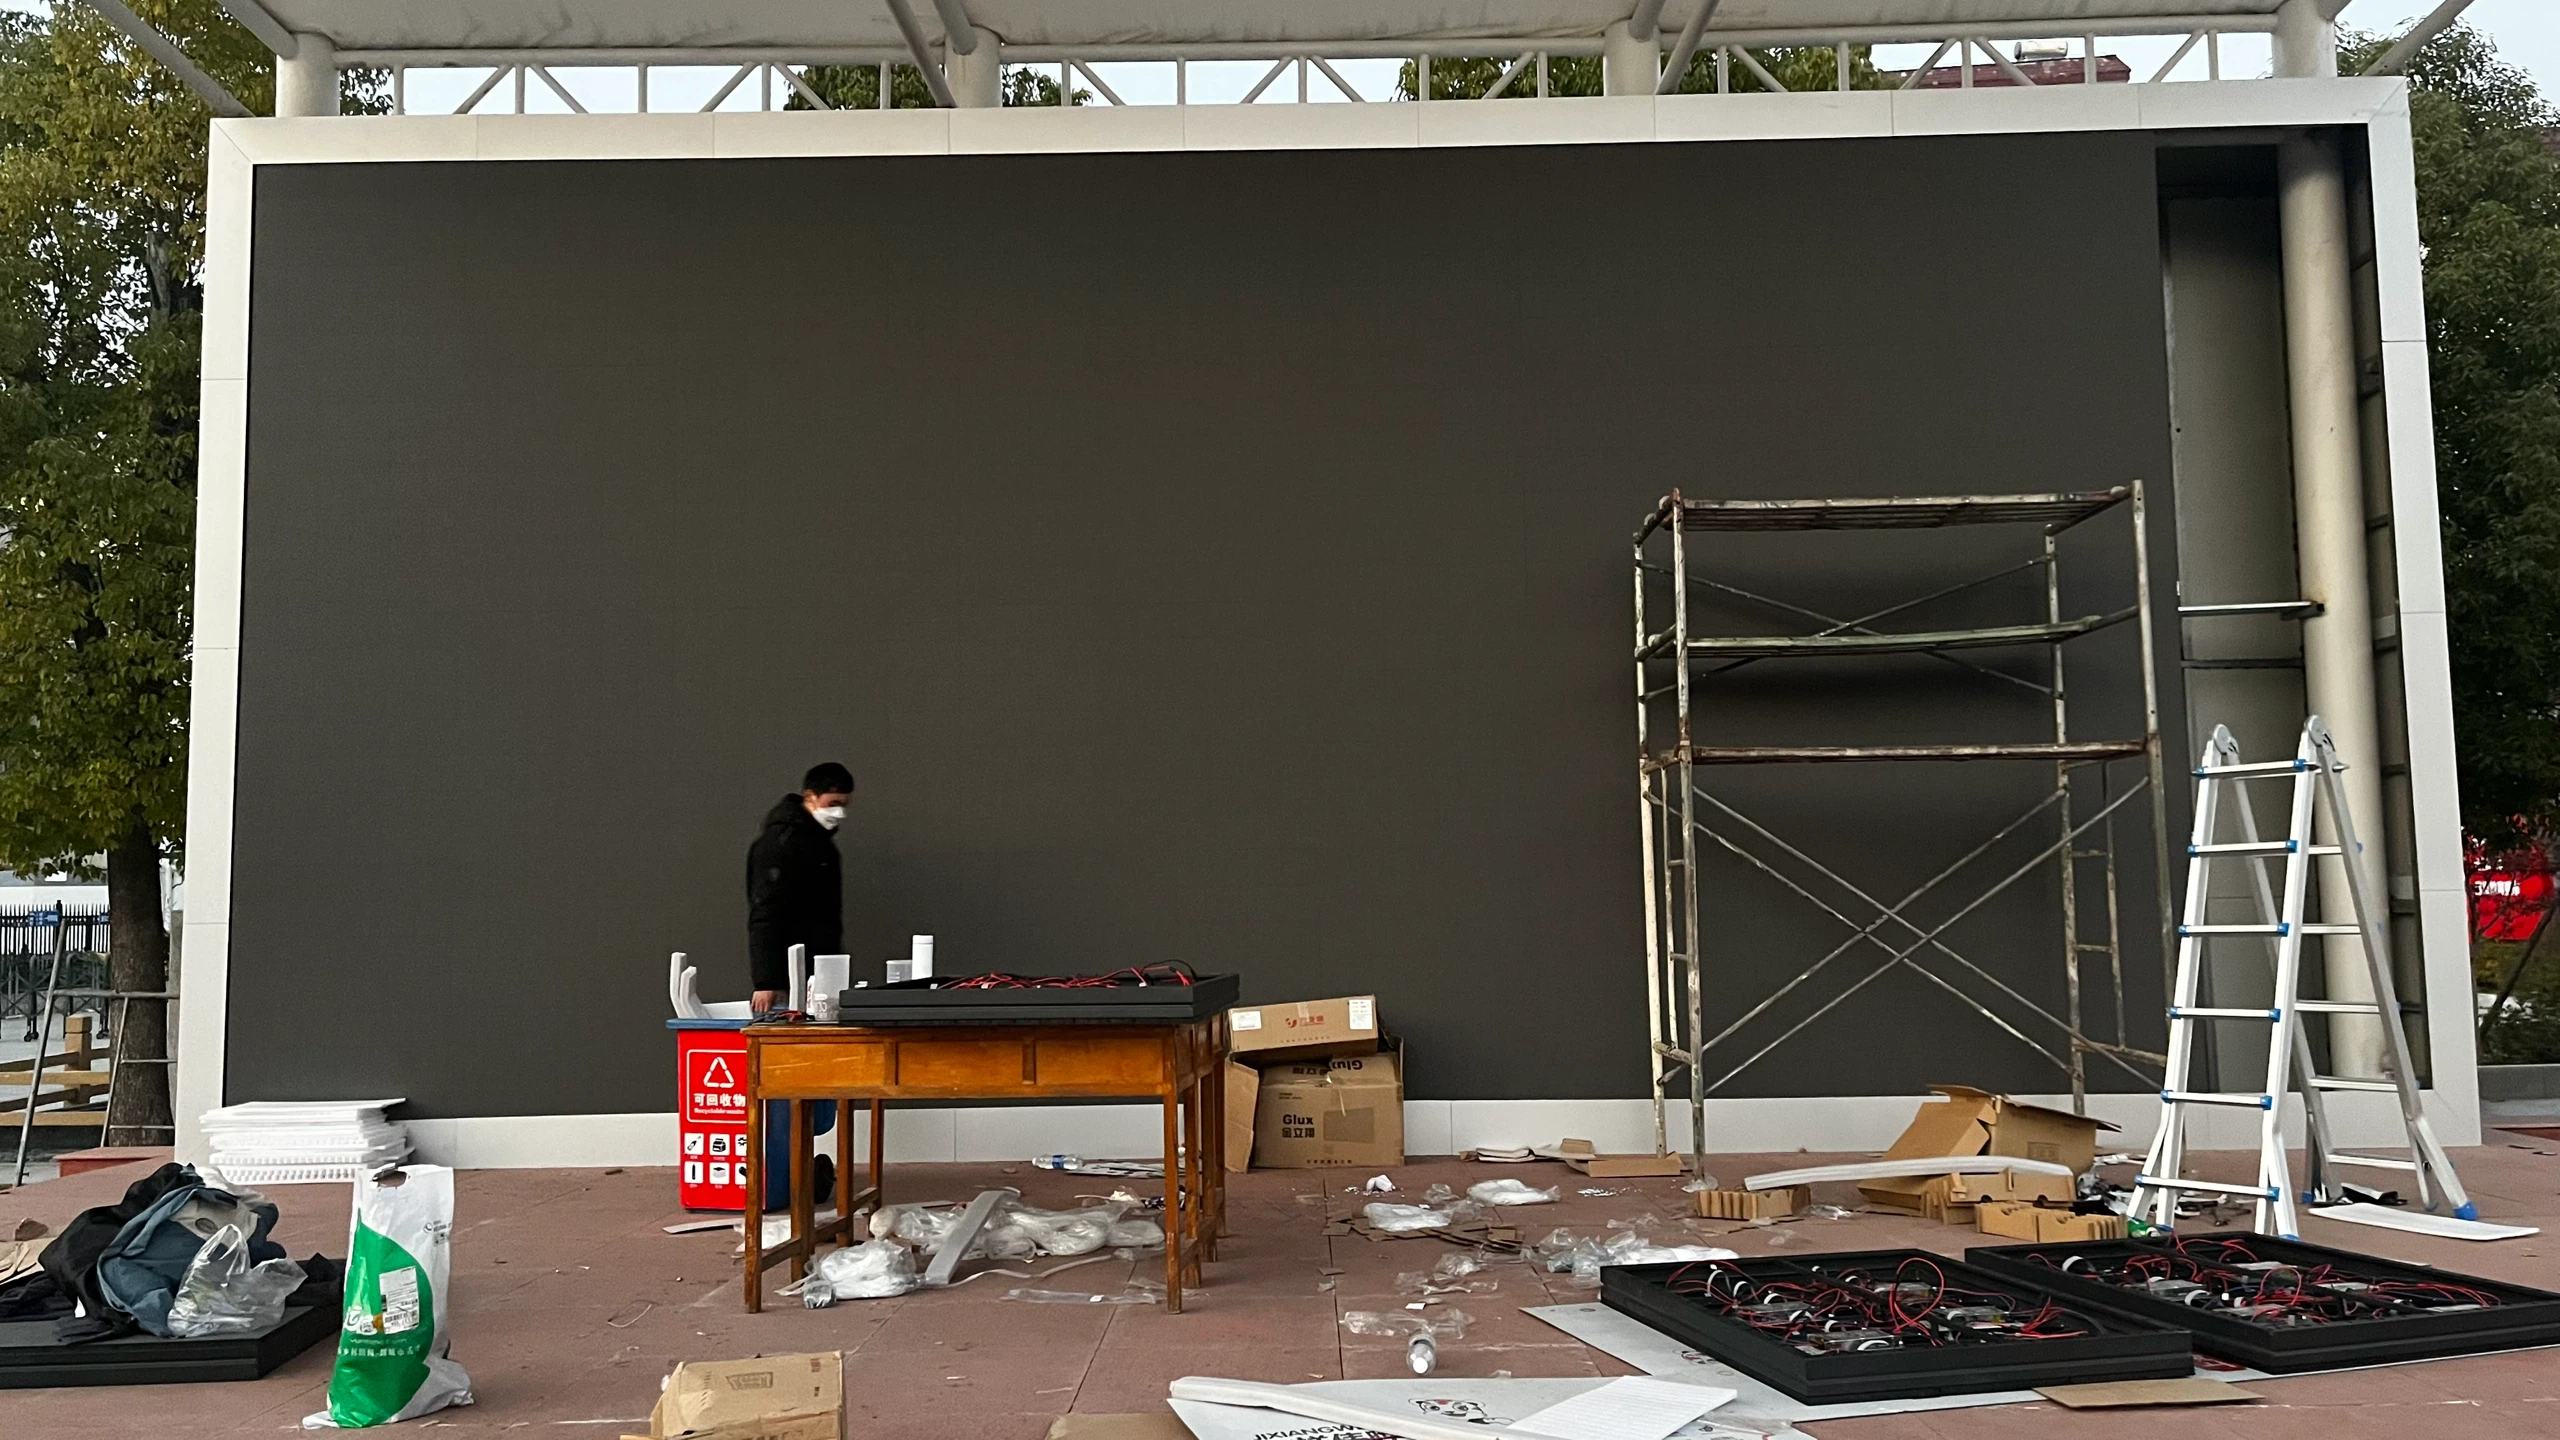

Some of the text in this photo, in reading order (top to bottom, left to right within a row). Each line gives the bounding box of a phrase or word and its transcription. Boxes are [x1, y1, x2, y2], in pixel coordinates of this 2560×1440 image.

[693, 1093, 746, 1107] 可回收物
[1282, 1114, 1314, 1125] Glux
[1281, 1127, 1315, 1138] 金立翔
[1253, 1424, 1363, 1440] JIXIANGW
